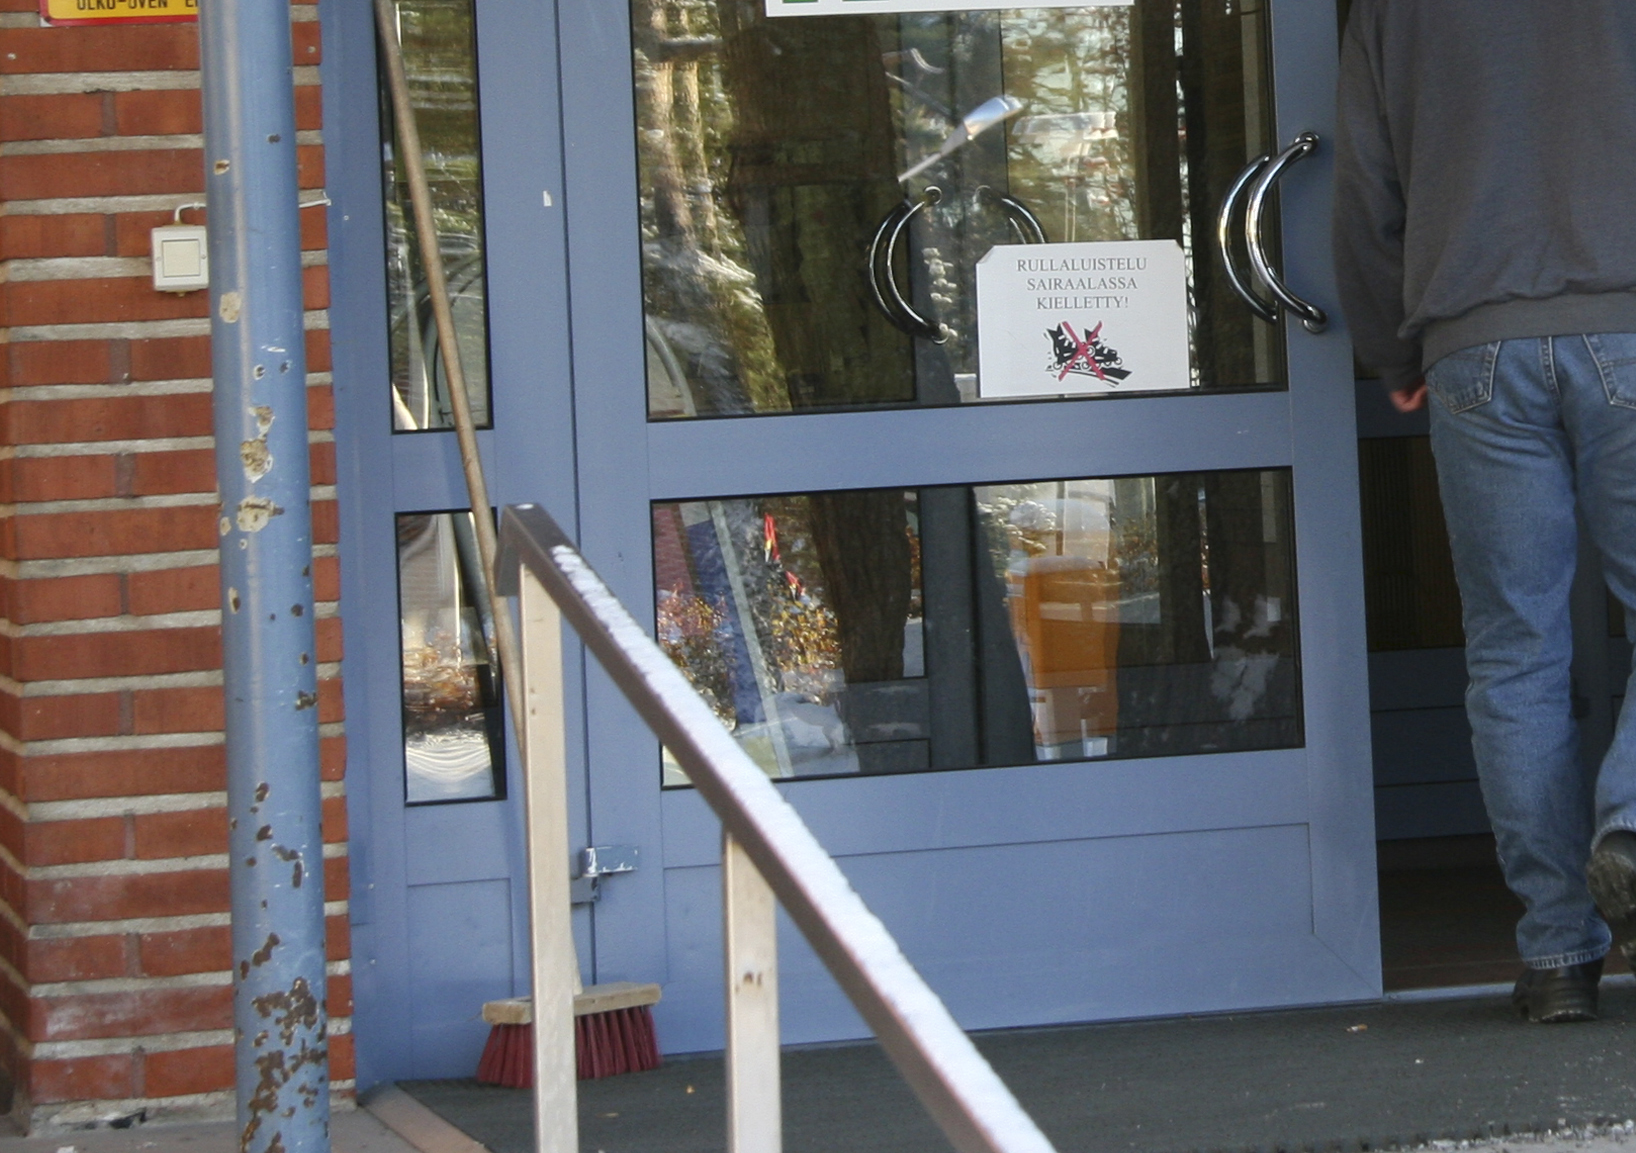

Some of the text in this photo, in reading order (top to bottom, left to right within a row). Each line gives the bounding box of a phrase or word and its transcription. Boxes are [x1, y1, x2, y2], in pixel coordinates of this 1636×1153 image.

[1016, 257, 1148, 273] RULLALUISTELU
[1026, 276, 1139, 292] SAIRAALASSA
[1036, 295, 1130, 311] KIELLETTY!
